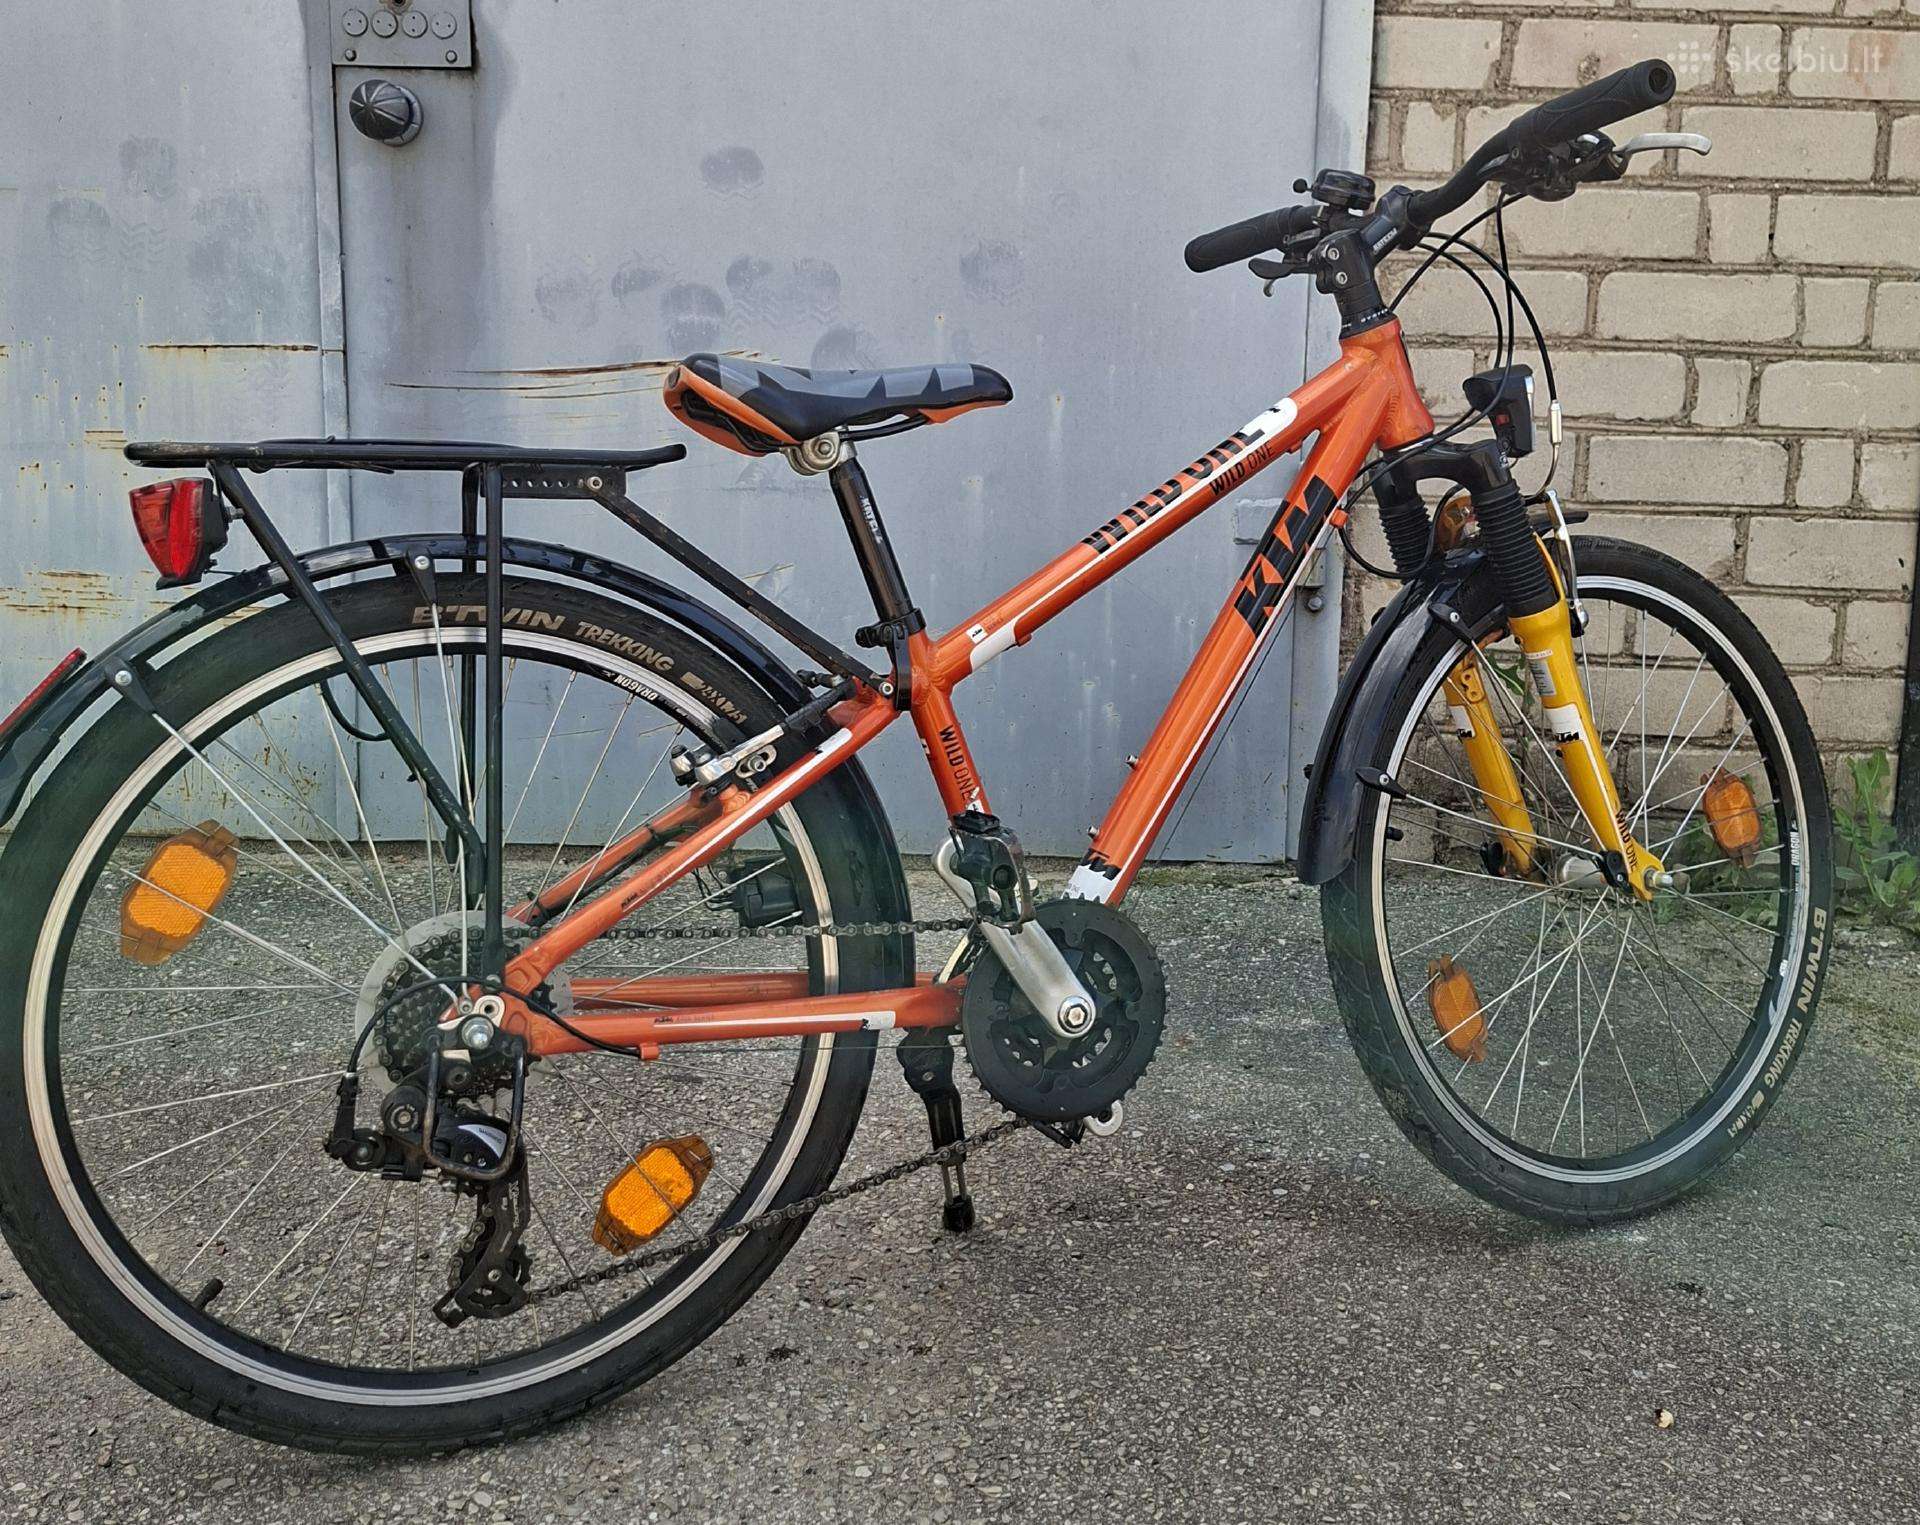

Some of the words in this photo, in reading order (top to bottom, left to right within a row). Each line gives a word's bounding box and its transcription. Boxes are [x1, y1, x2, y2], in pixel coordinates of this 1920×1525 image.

[1208, 463, 1248, 497] WILD
[1248, 443, 1274, 473] ONE
[1234, 474, 1338, 638] KTM
[575, 621, 676, 672] TREKKING
[612, 674, 660, 701] DRAGON
[939, 724, 966, 767] WILD
[953, 766, 977, 802] ONE
[1615, 810, 1632, 843] WILD
[1624, 841, 1639, 872] ONE
[1790, 831, 1800, 867] DRAGON
[1764, 1017, 1804, 1090] TREKKING
